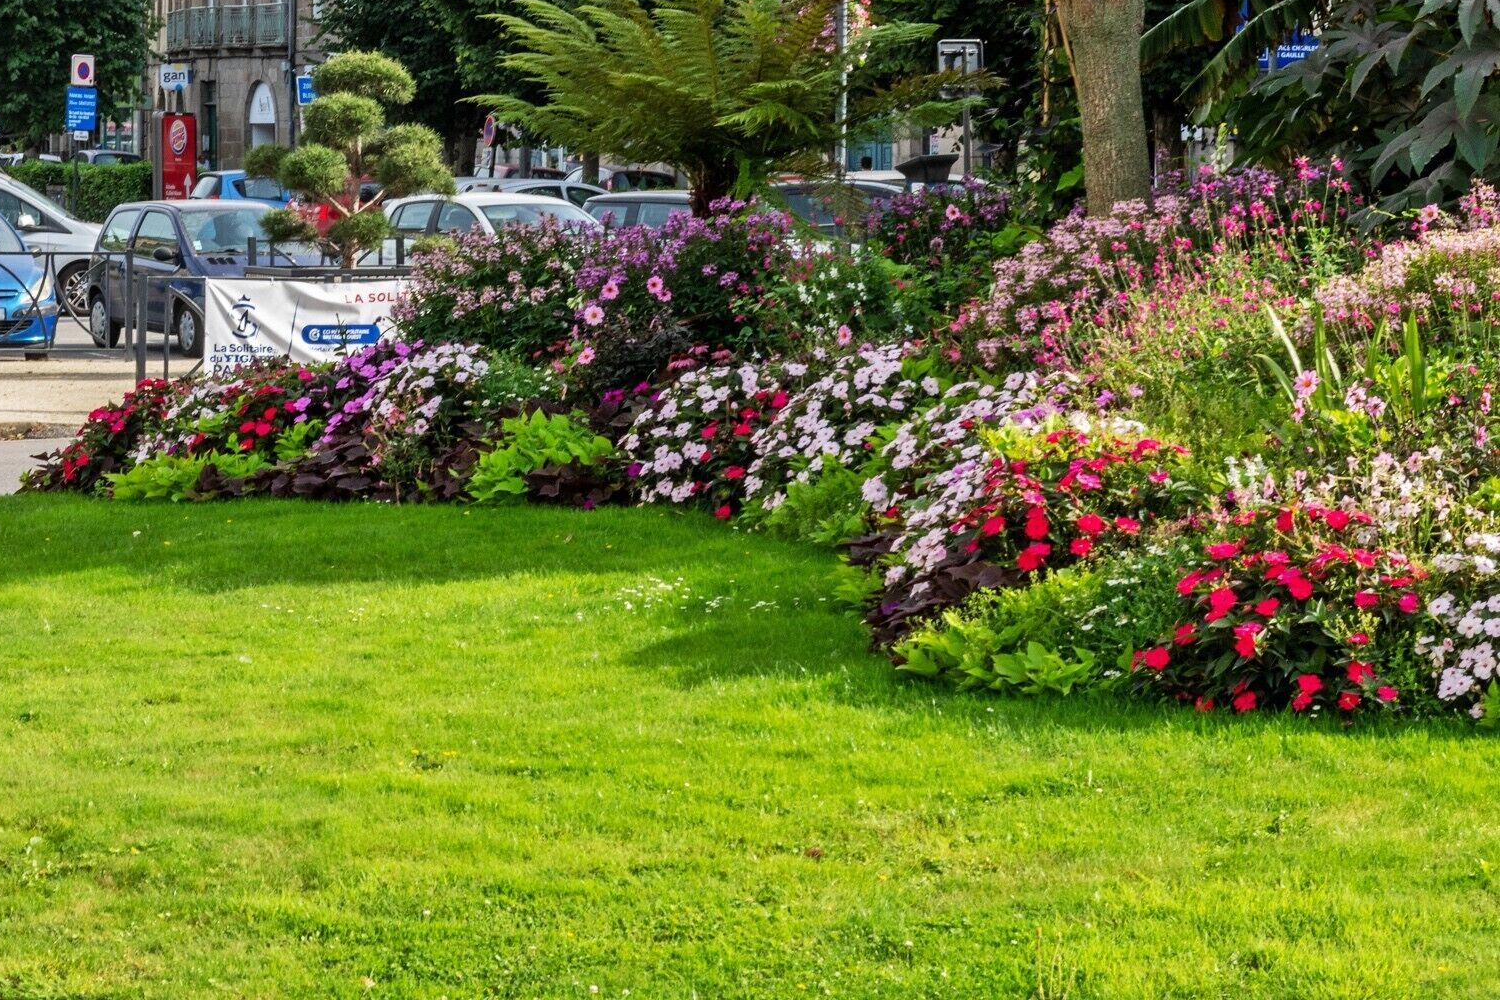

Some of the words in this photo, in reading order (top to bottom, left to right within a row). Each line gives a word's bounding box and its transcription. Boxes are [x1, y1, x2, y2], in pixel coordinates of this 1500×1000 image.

[163, 71, 186, 83] gan
[345, 294, 364, 304] LA
[214, 343, 227, 353] La
[229, 343, 273, 354] Solitaire
[209, 354, 222, 363] du
